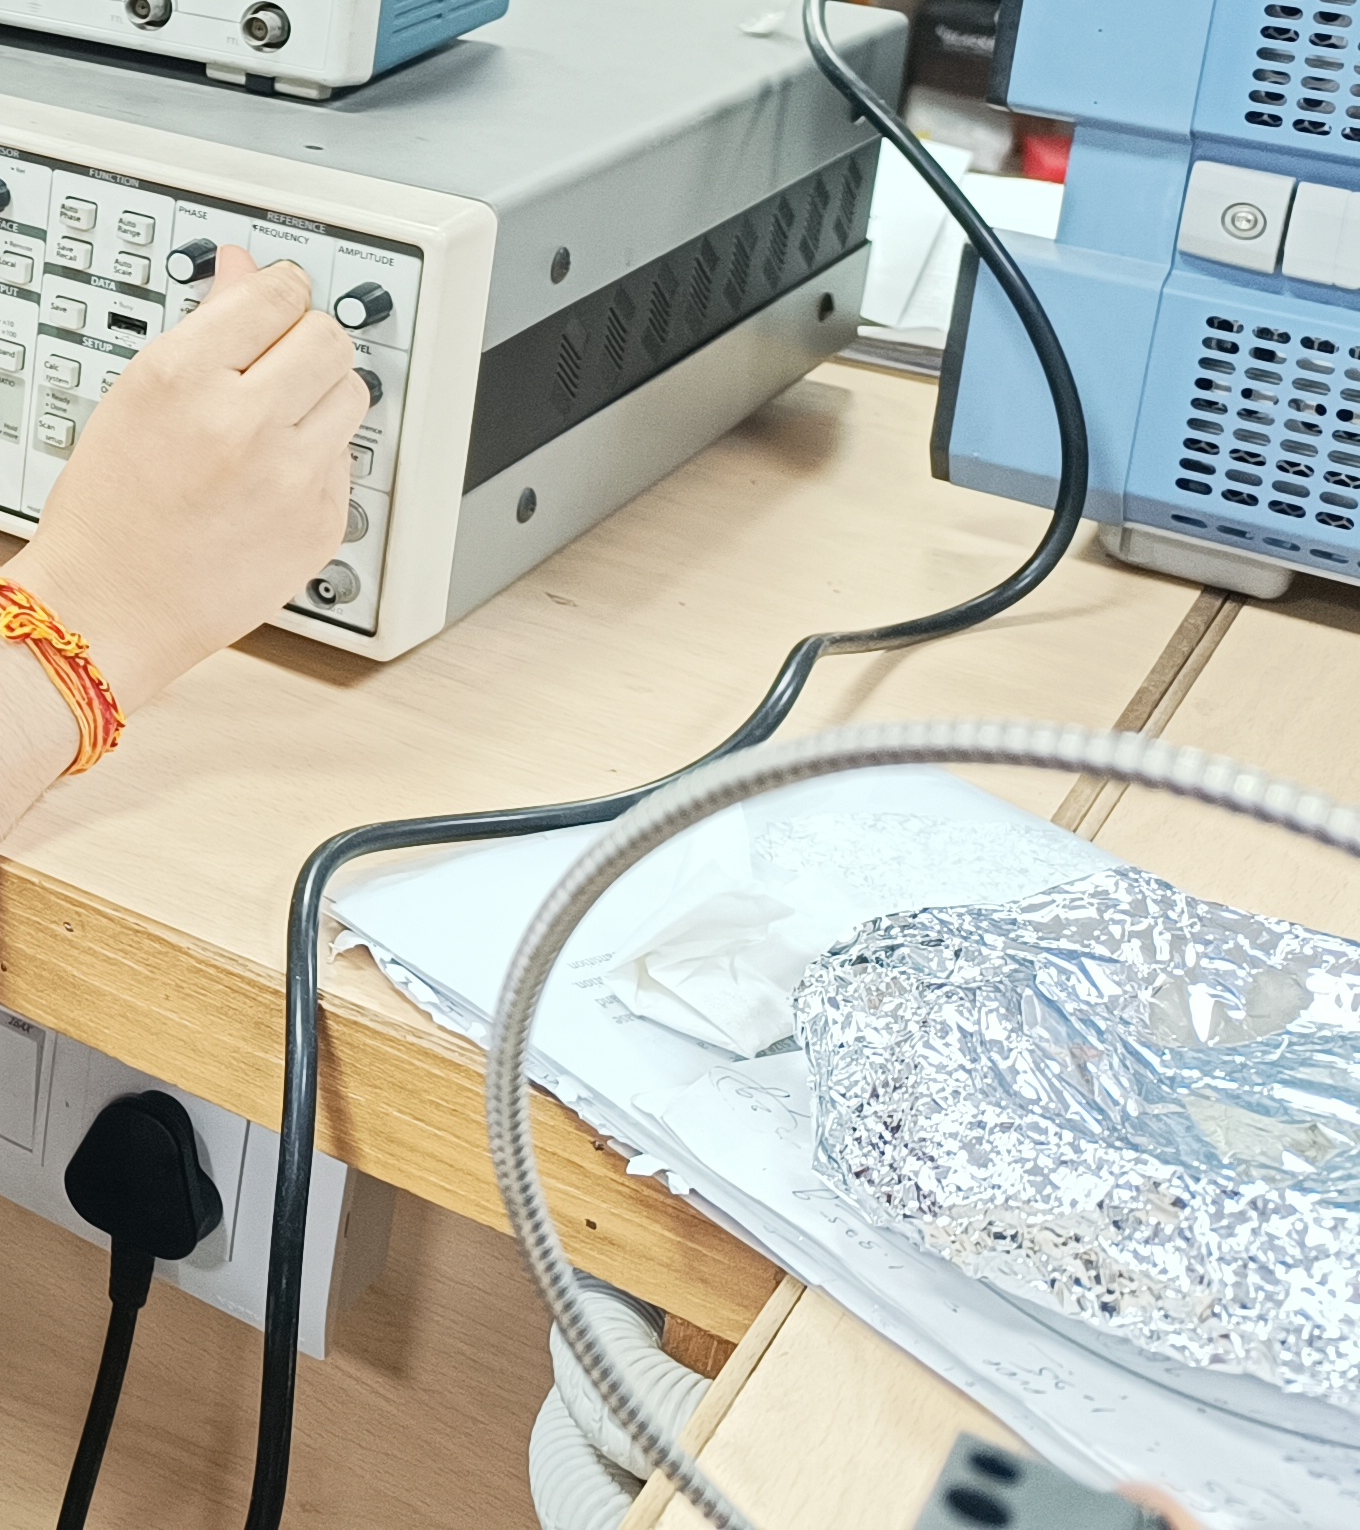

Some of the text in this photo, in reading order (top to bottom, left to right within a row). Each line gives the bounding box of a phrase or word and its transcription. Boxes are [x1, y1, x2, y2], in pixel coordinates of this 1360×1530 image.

[89, 169, 139, 188] FUNCTION
[61, 203, 78, 214] Auto
[179, 205, 208, 220] PHASE
[60, 210, 81, 224] Phase
[118, 217, 136, 229] Auto
[267, 211, 327, 234] REFERENCE
[118, 224, 141, 238] Range
[253, 225, 310, 245] FREQUENCY
[57, 242, 74, 254] Save
[56, 250, 77, 262] Recall
[338, 245, 395, 267] AMPLITUDE
[114, 258, 132, 269] Auto
[114, 265, 133, 276] Scale
[90, 276, 116, 291] DATA
[51, 302, 67, 314] Save
[82, 336, 113, 353] SETUP
[44, 360, 59, 372] Calc
[46, 374, 69, 387] system
[51, 392, 71, 405] Ready
[50, 402, 67, 414] Done
[4, 422, 18, 432] Hold
[39, 420, 56, 432] Scan
[3, 430, 19, 441] more
[45, 434, 64, 446] setup
